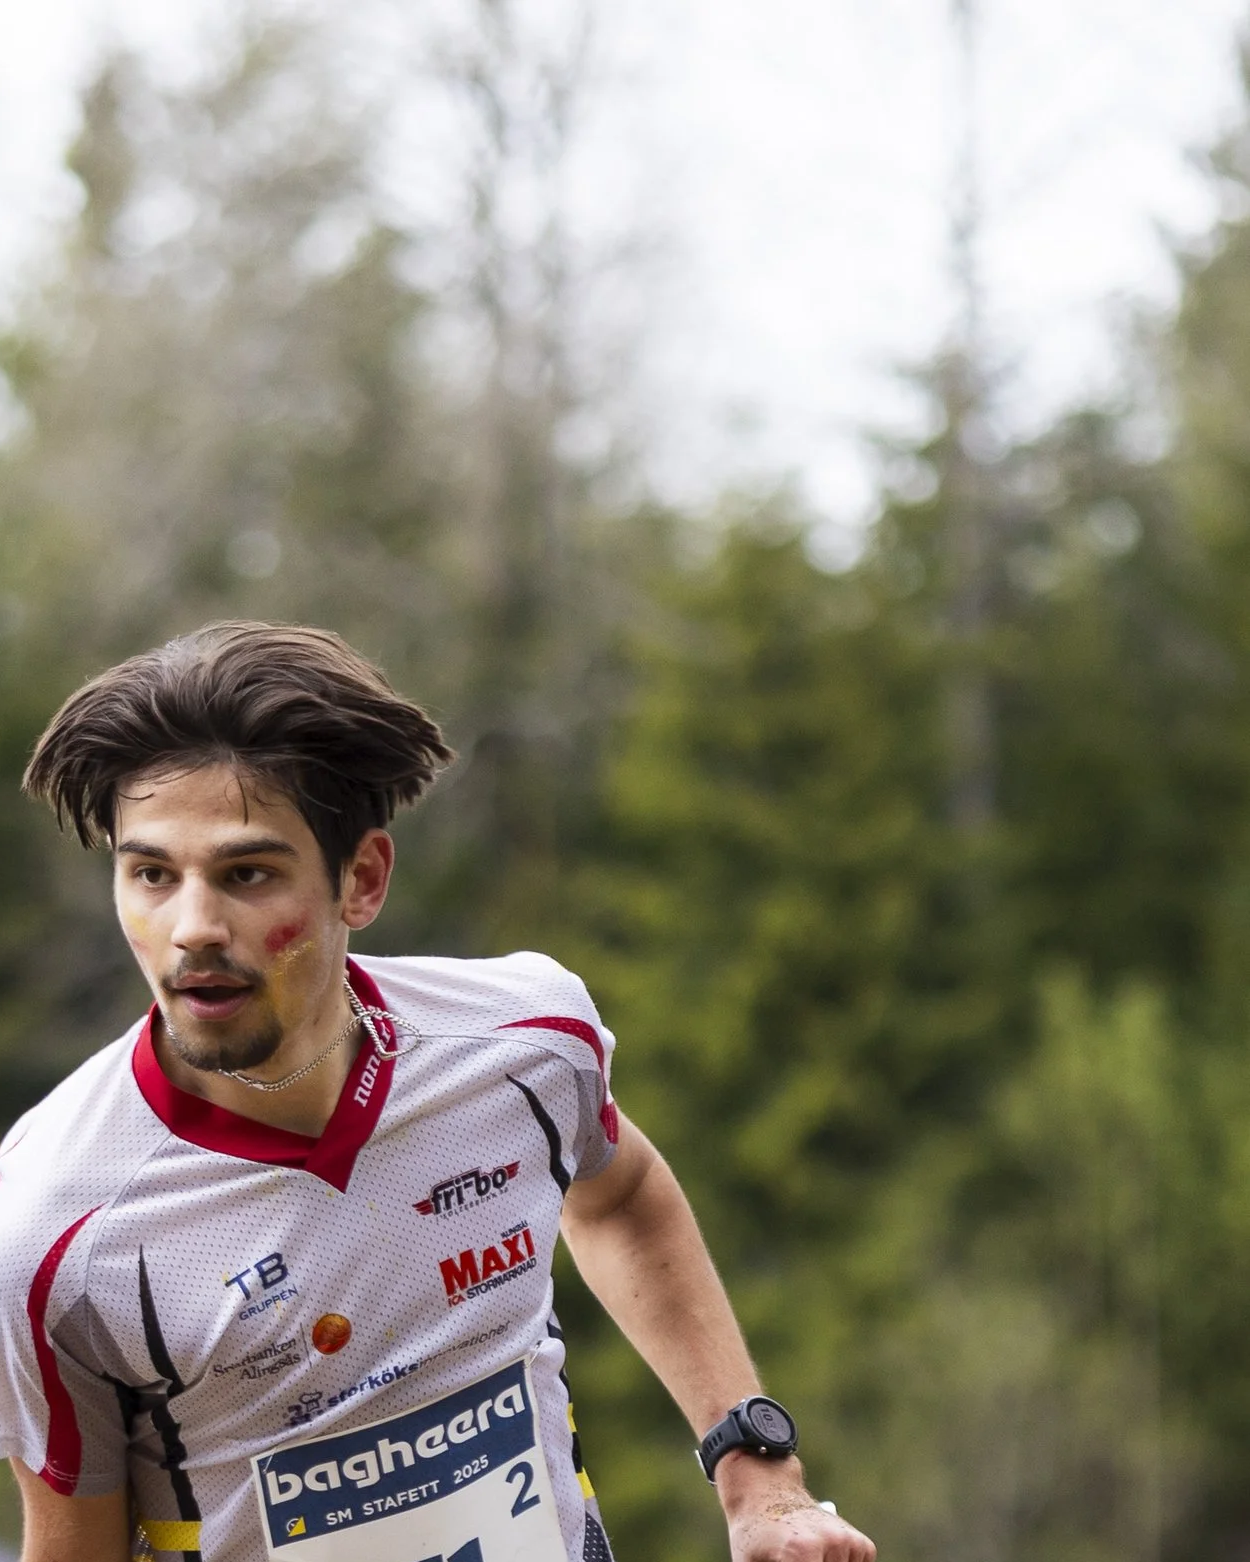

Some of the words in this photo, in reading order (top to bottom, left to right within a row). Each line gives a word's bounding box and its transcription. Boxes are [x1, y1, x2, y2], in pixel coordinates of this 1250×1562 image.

[431, 1167, 509, 1215] fri-bo
[225, 1252, 289, 1301] TB
[438, 1228, 536, 1297] MAXI
[466, 1257, 537, 1299] STORMARKNAD
[239, 1284, 300, 1321] GRUPPEN
[266, 1384, 526, 1506] bagheera
[326, 1508, 353, 1526] SM
[362, 1480, 440, 1516] STAFETT
[453, 1455, 490, 1485] 2025
[505, 1461, 542, 1518] 2
